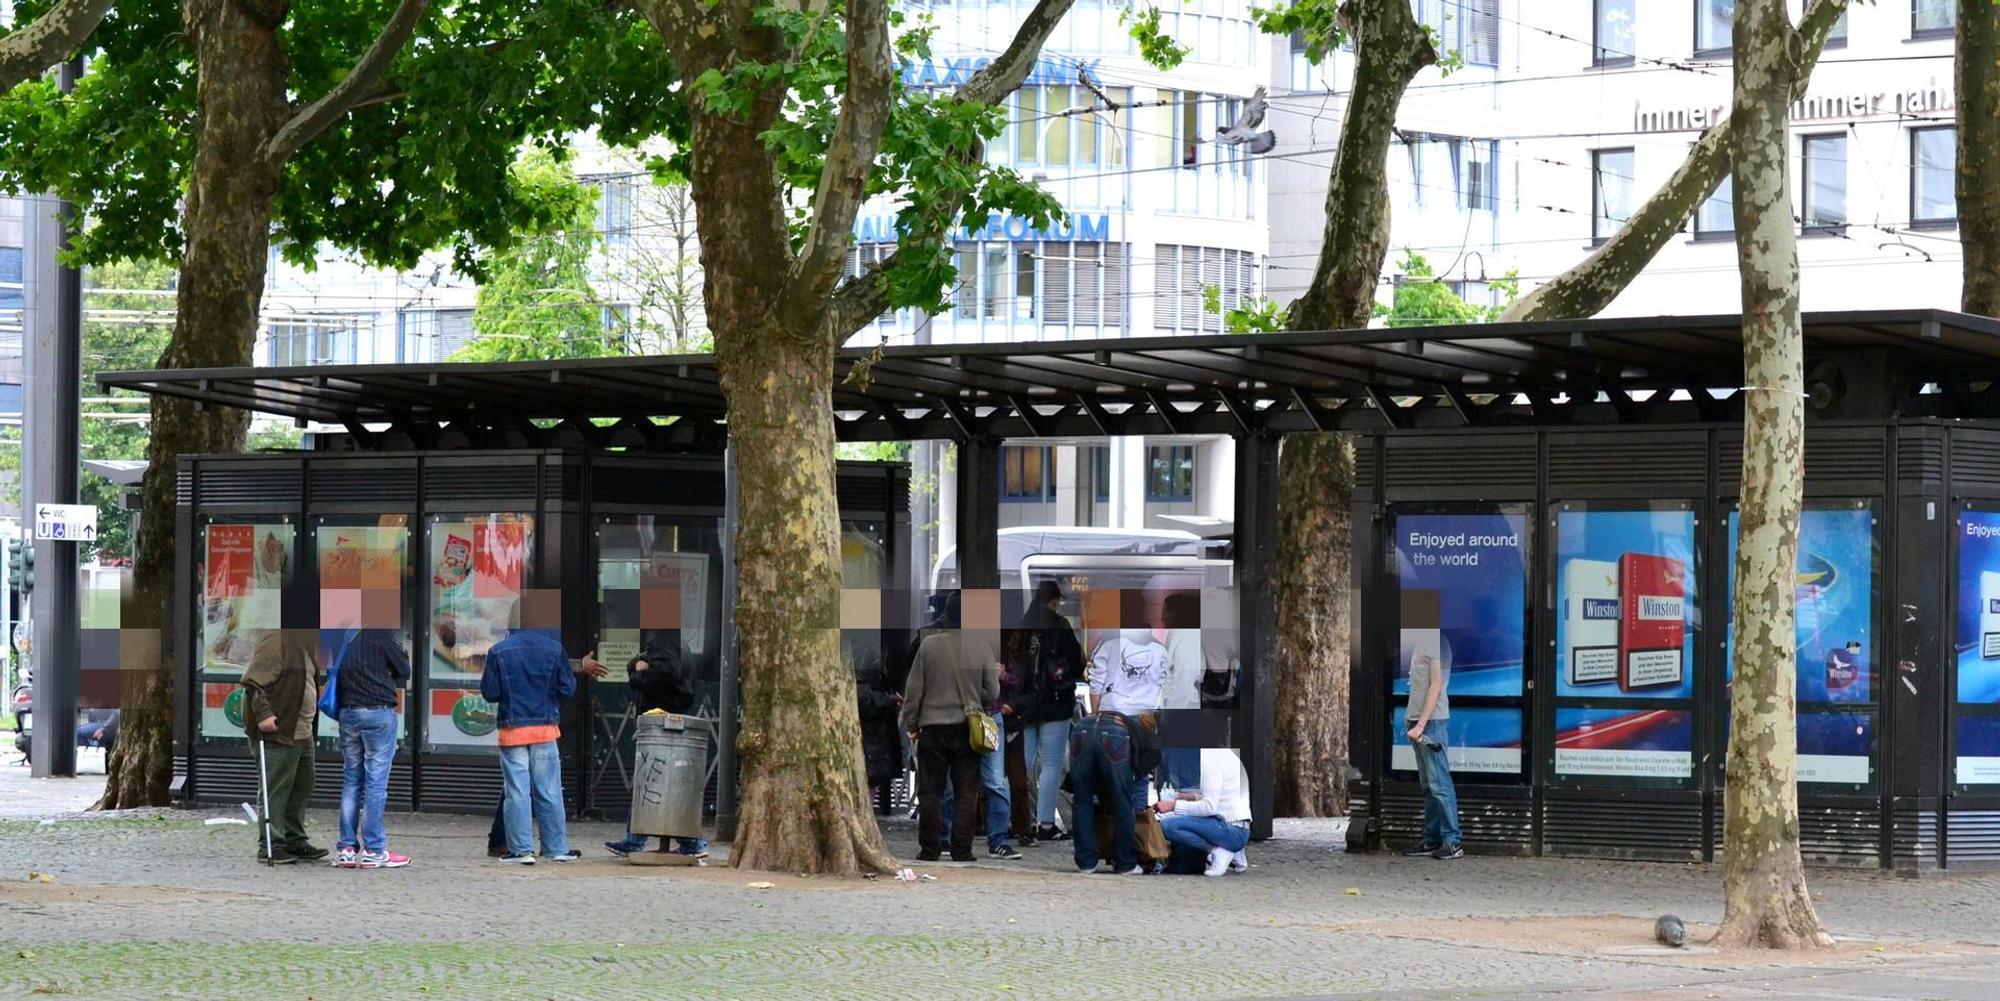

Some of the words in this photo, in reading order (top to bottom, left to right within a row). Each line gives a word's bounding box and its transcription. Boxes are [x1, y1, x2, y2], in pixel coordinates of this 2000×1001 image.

[53, 509, 66, 518] WC
[1410, 533, 1465, 549] Enjoyed
[1469, 533, 1518, 546] around
[1413, 552, 1436, 566] the
[1440, 552, 1479, 566] world
[1643, 597, 1681, 617] Winston
